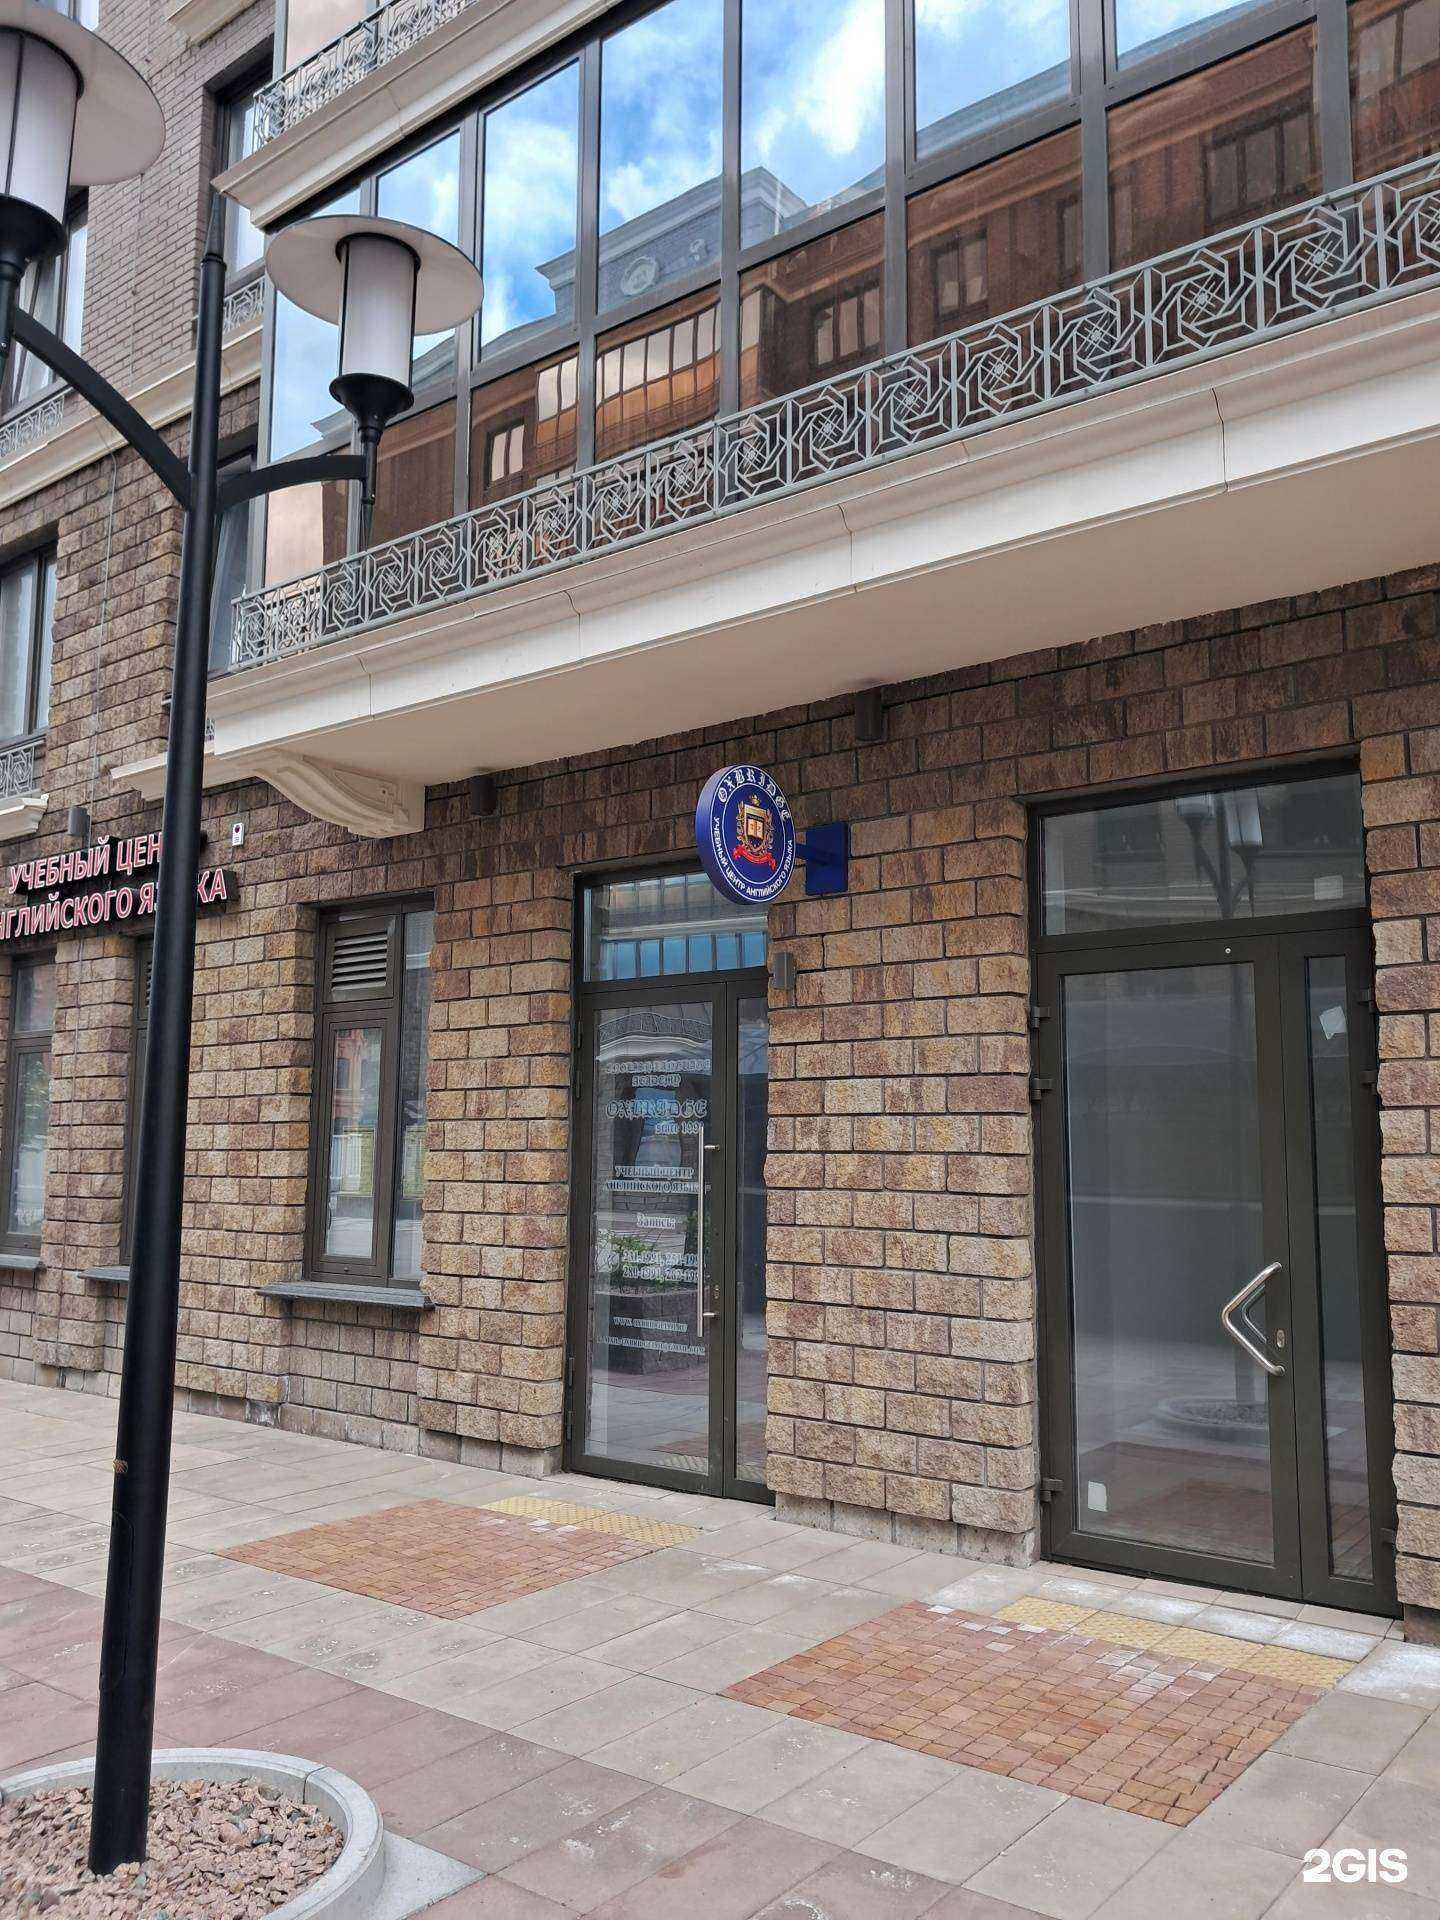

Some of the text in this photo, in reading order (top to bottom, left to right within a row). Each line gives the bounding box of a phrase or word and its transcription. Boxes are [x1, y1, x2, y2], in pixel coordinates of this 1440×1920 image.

[718, 768, 791, 820] OXBRIDGE
[8, 831, 163, 894] УЧЕБНЫЙ ЦЕН
[138, 868, 227, 913] ЯКА
